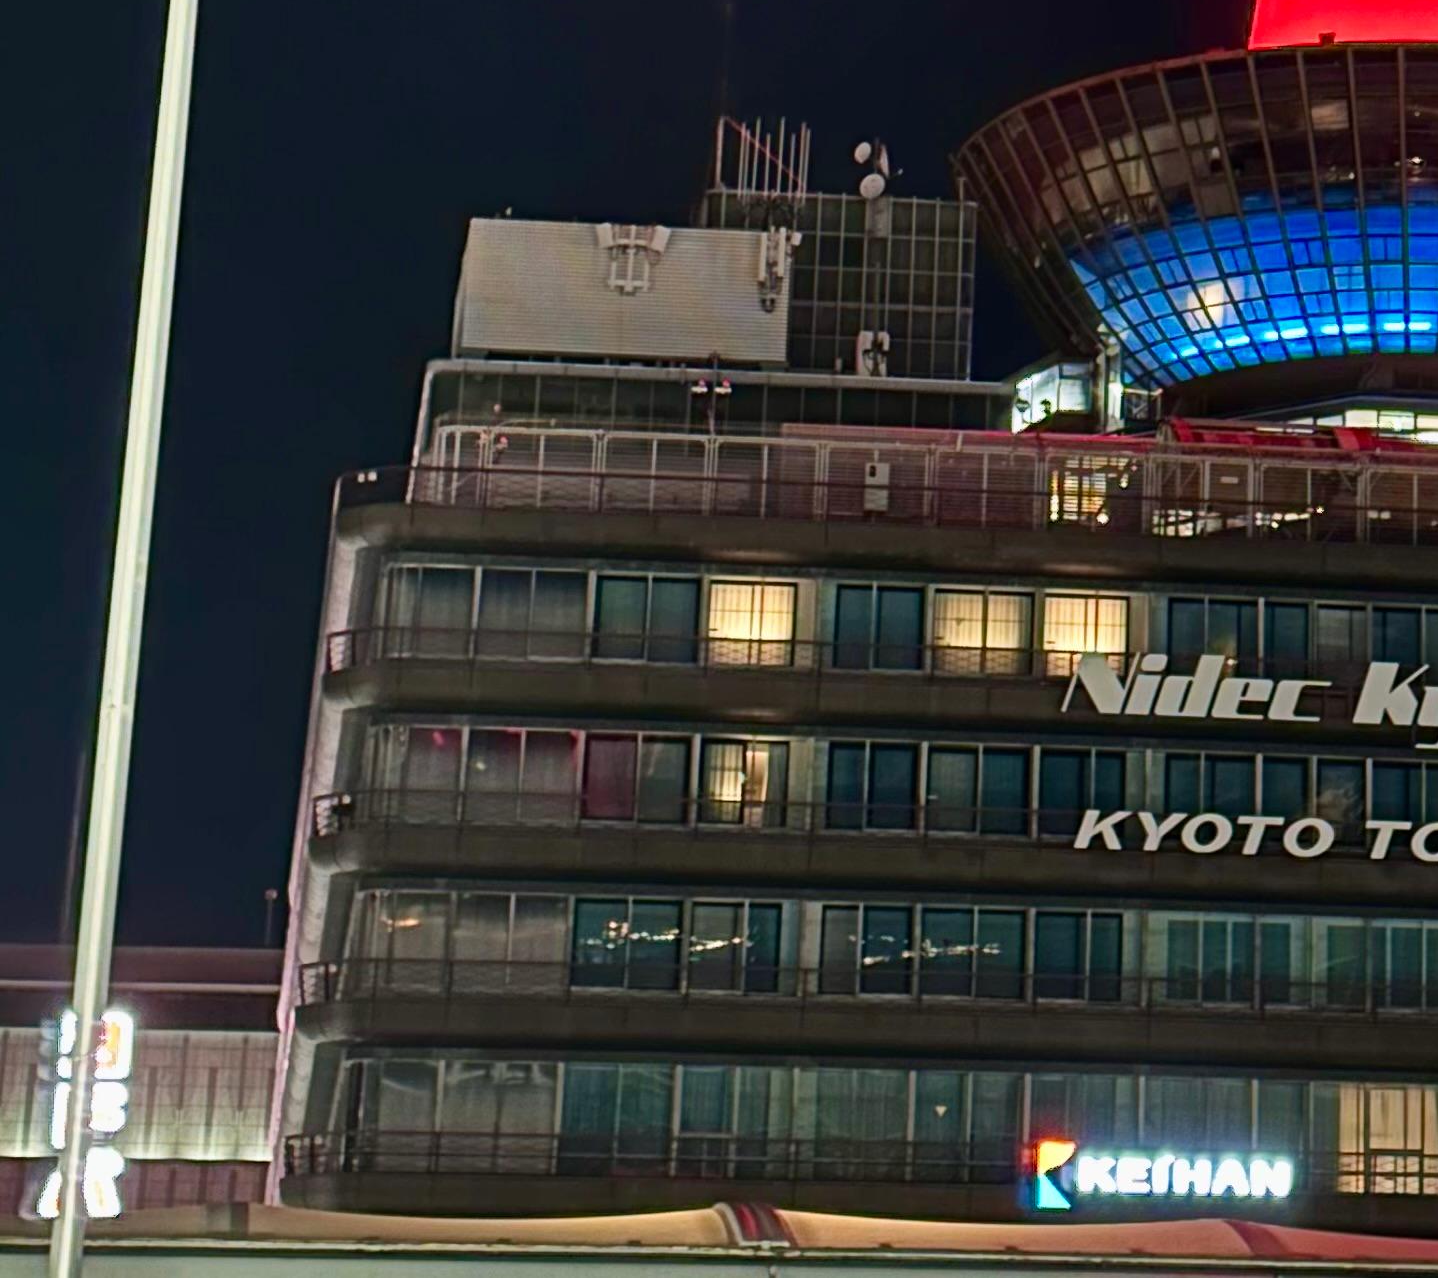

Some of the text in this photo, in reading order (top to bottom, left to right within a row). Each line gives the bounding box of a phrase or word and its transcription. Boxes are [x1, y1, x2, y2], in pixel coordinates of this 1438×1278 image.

[1061, 651, 1333, 722] Nidec
[1073, 809, 1335, 858] KYOTO
[1077, 1153, 1292, 1197] KEIHAN
